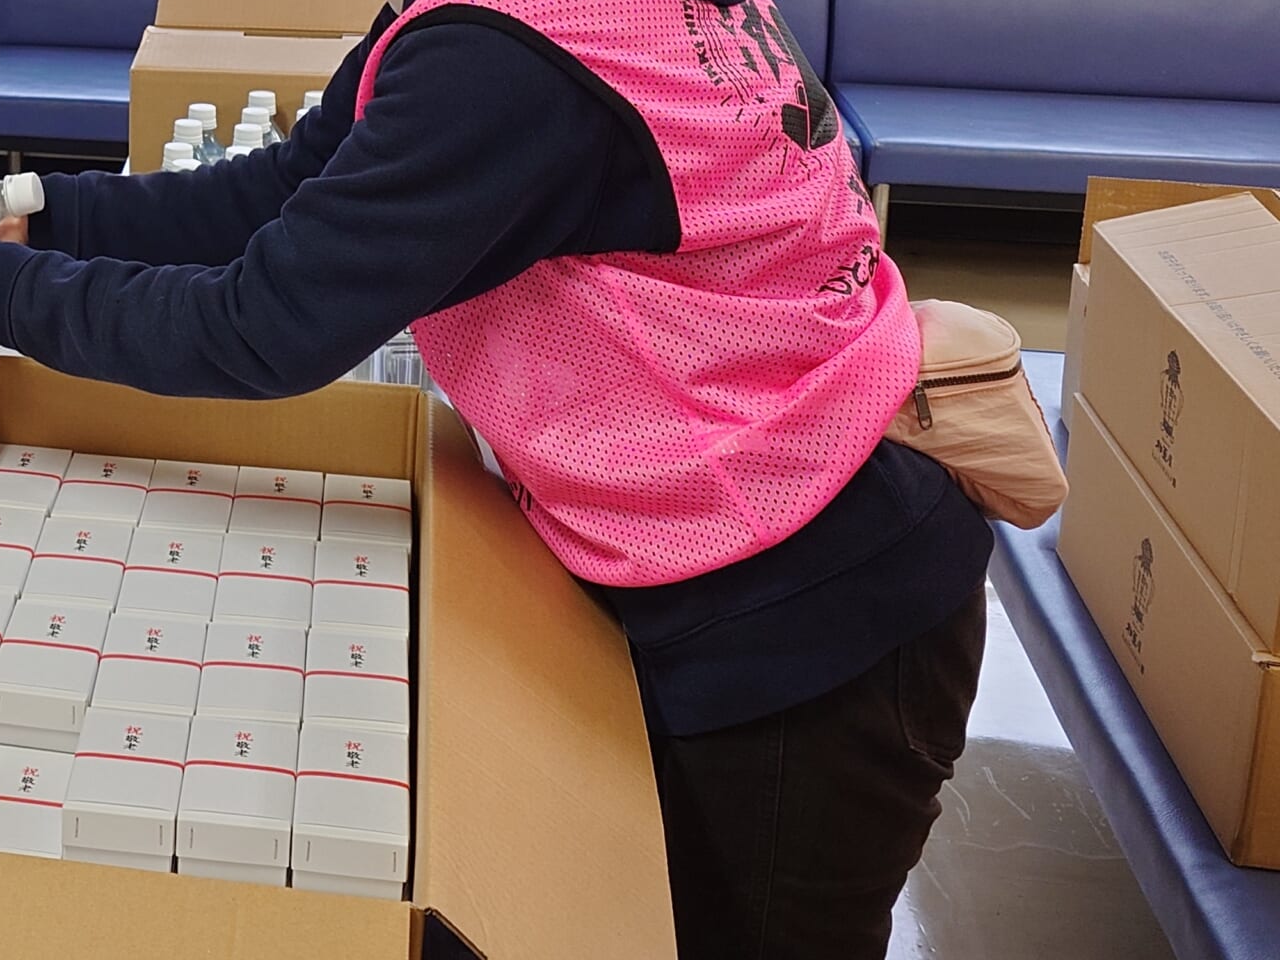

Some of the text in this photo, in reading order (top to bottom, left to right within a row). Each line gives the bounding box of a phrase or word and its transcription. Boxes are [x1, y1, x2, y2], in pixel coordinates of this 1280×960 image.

[75, 531, 91, 551] 祝敬老
[168, 542, 184, 563] 祝敬老
[261, 547, 275, 568] 祝敬老
[355, 556, 370, 576] 祝敬老
[48, 615, 65, 638] 祝敬老
[146, 628, 163, 652] 祝敬老
[247, 634, 263, 658] 祝敬老
[349, 644, 366, 668] 祝敬老
[124, 725, 143, 750] 祝敬老
[235, 732, 253, 757] 祝敬老
[345, 741, 364, 768] 祝敬老
[18, 767, 39, 792] 祝敬老
